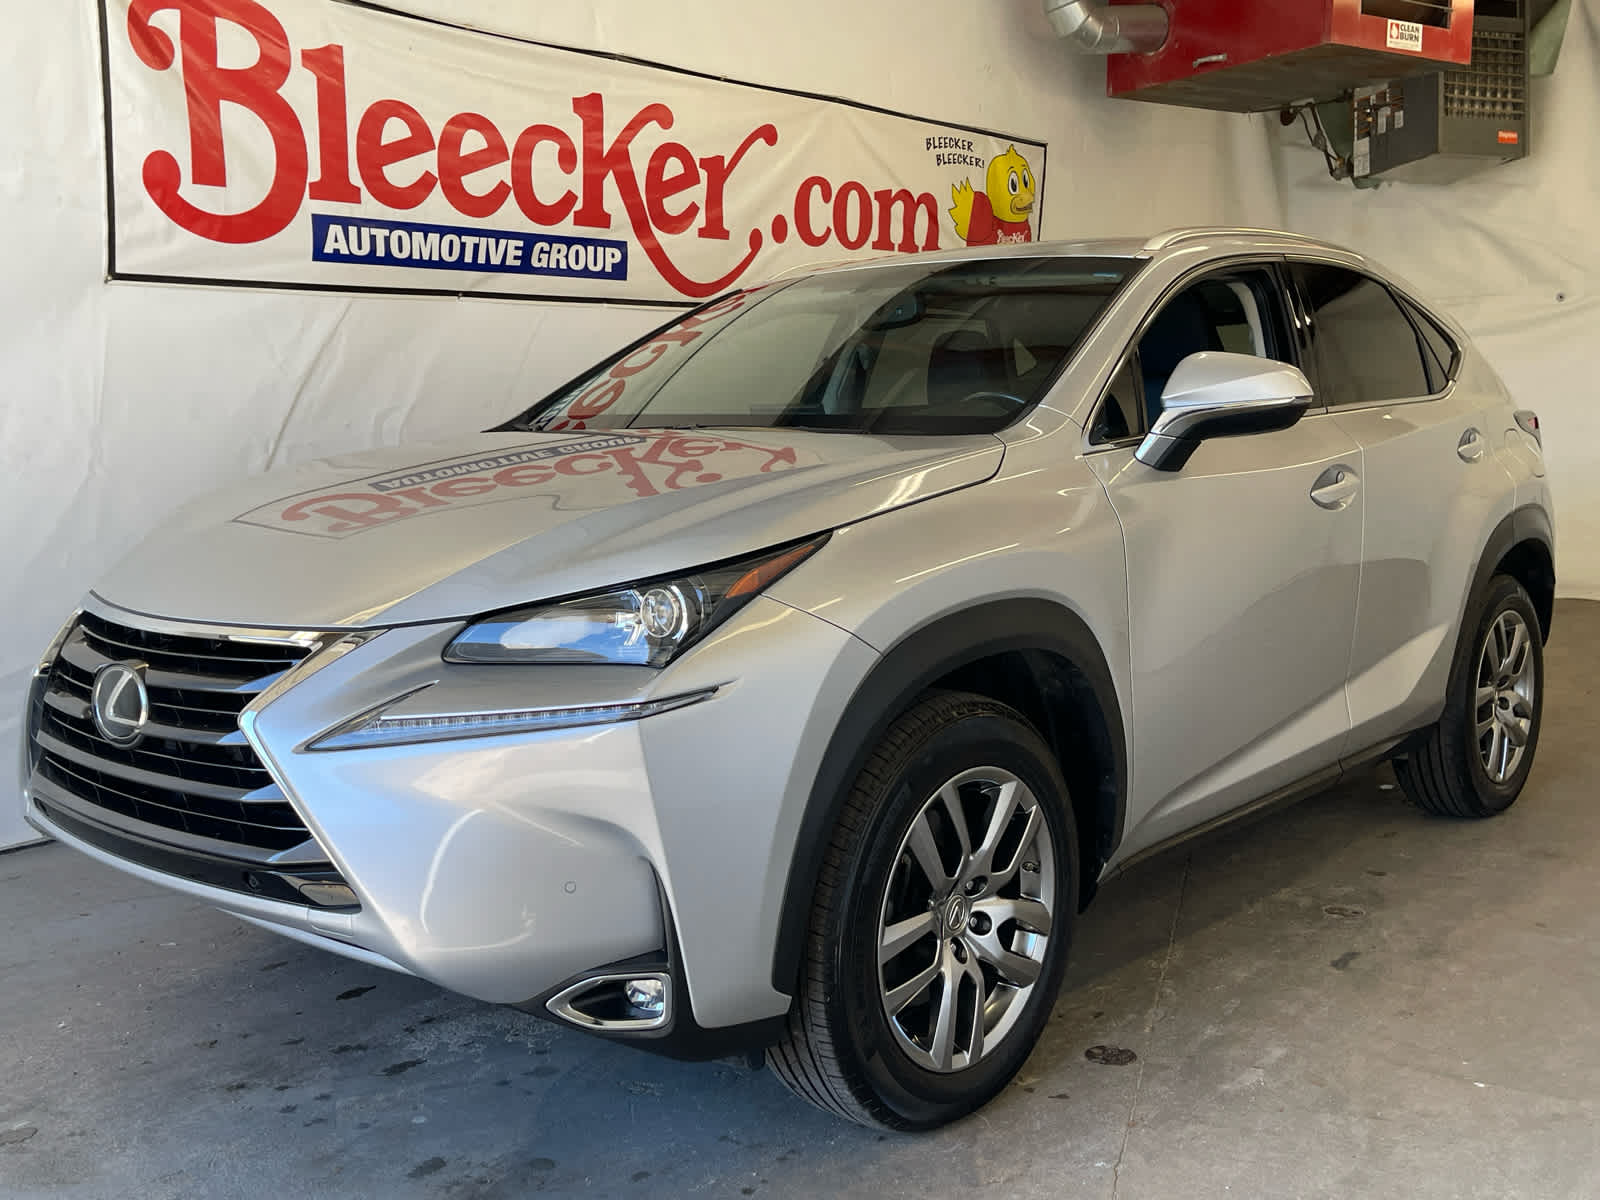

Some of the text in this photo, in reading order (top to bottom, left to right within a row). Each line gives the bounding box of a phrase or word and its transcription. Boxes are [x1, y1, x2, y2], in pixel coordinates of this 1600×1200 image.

[1400, 24, 1420, 33] CLEAN
[1400, 32, 1420, 42] BURN
[926, 136, 974, 152] BLEECKER
[936, 153, 985, 168] BLEECKER!
[323, 223, 622, 272] AUTOMOTIVE GROUP
